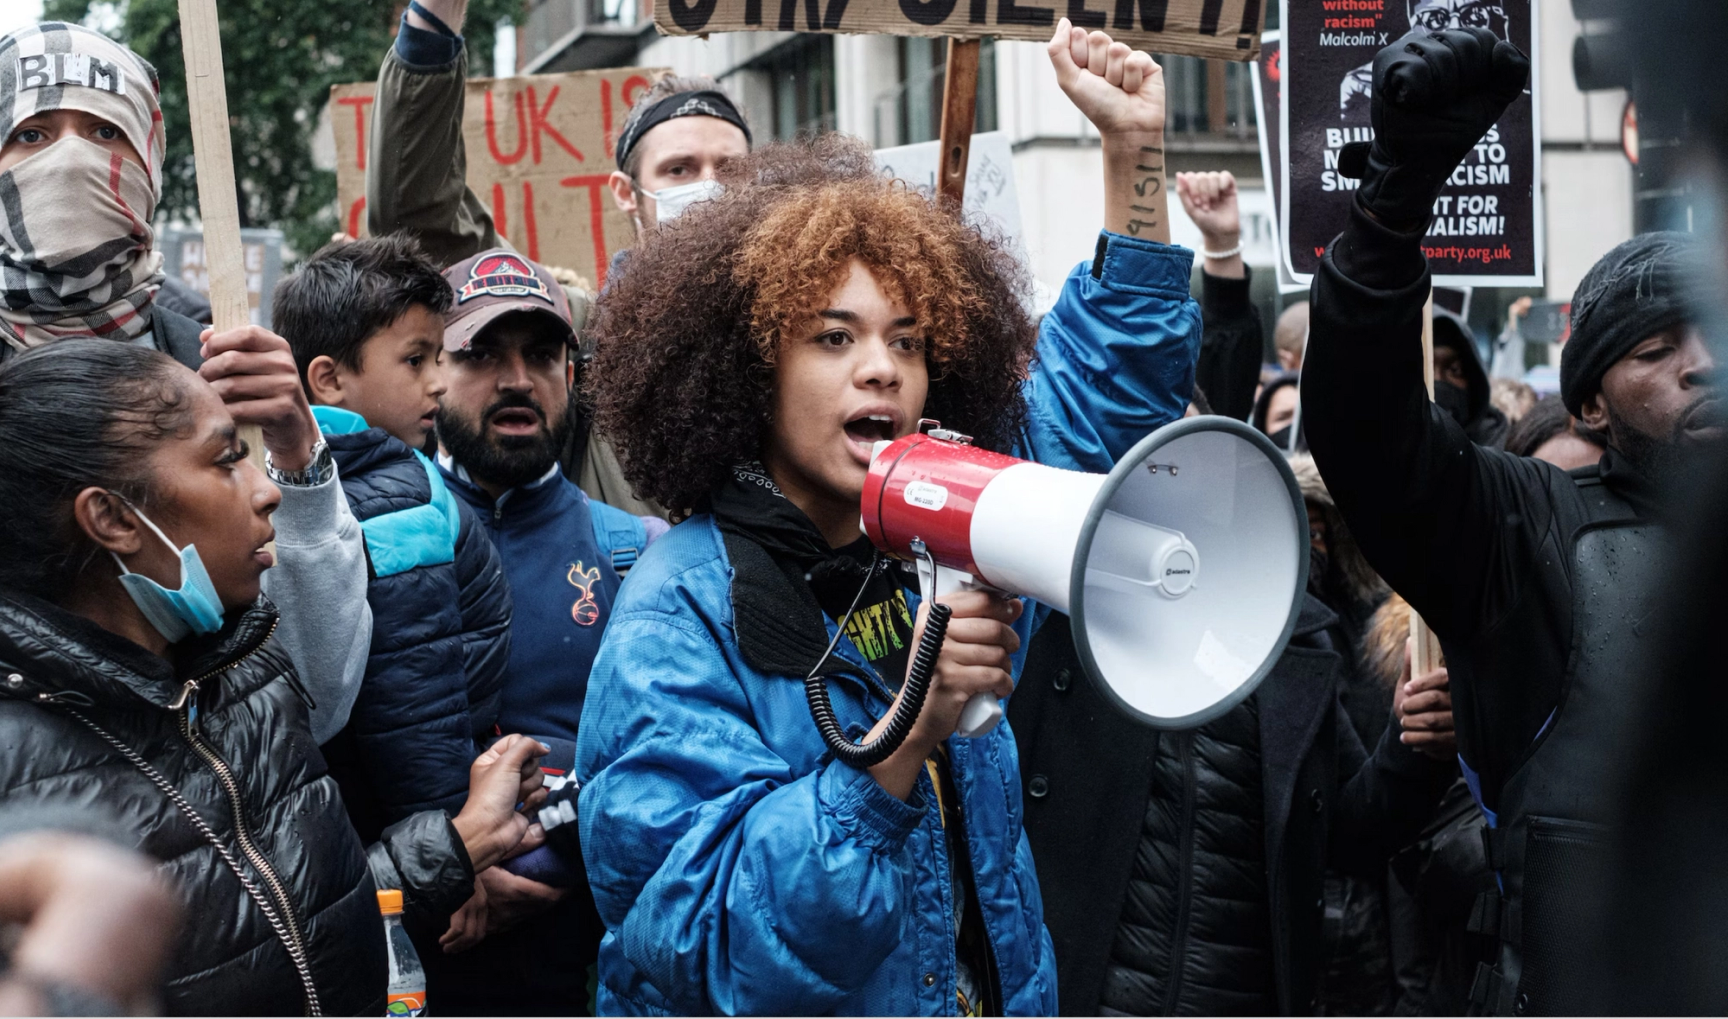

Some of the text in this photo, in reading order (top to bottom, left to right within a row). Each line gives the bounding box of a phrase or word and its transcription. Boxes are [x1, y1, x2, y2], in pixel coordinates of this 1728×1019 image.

[1322, 0, 1384, 11] without
[1324, 13, 1383, 28] racism"
[1319, 31, 1389, 47] Malcolm X
[19, 54, 119, 92] BLM
[484, 84, 585, 166] UK
[1473, 143, 1506, 164] TO
[1445, 164, 1510, 186] CISM
[1457, 195, 1499, 215] FOR
